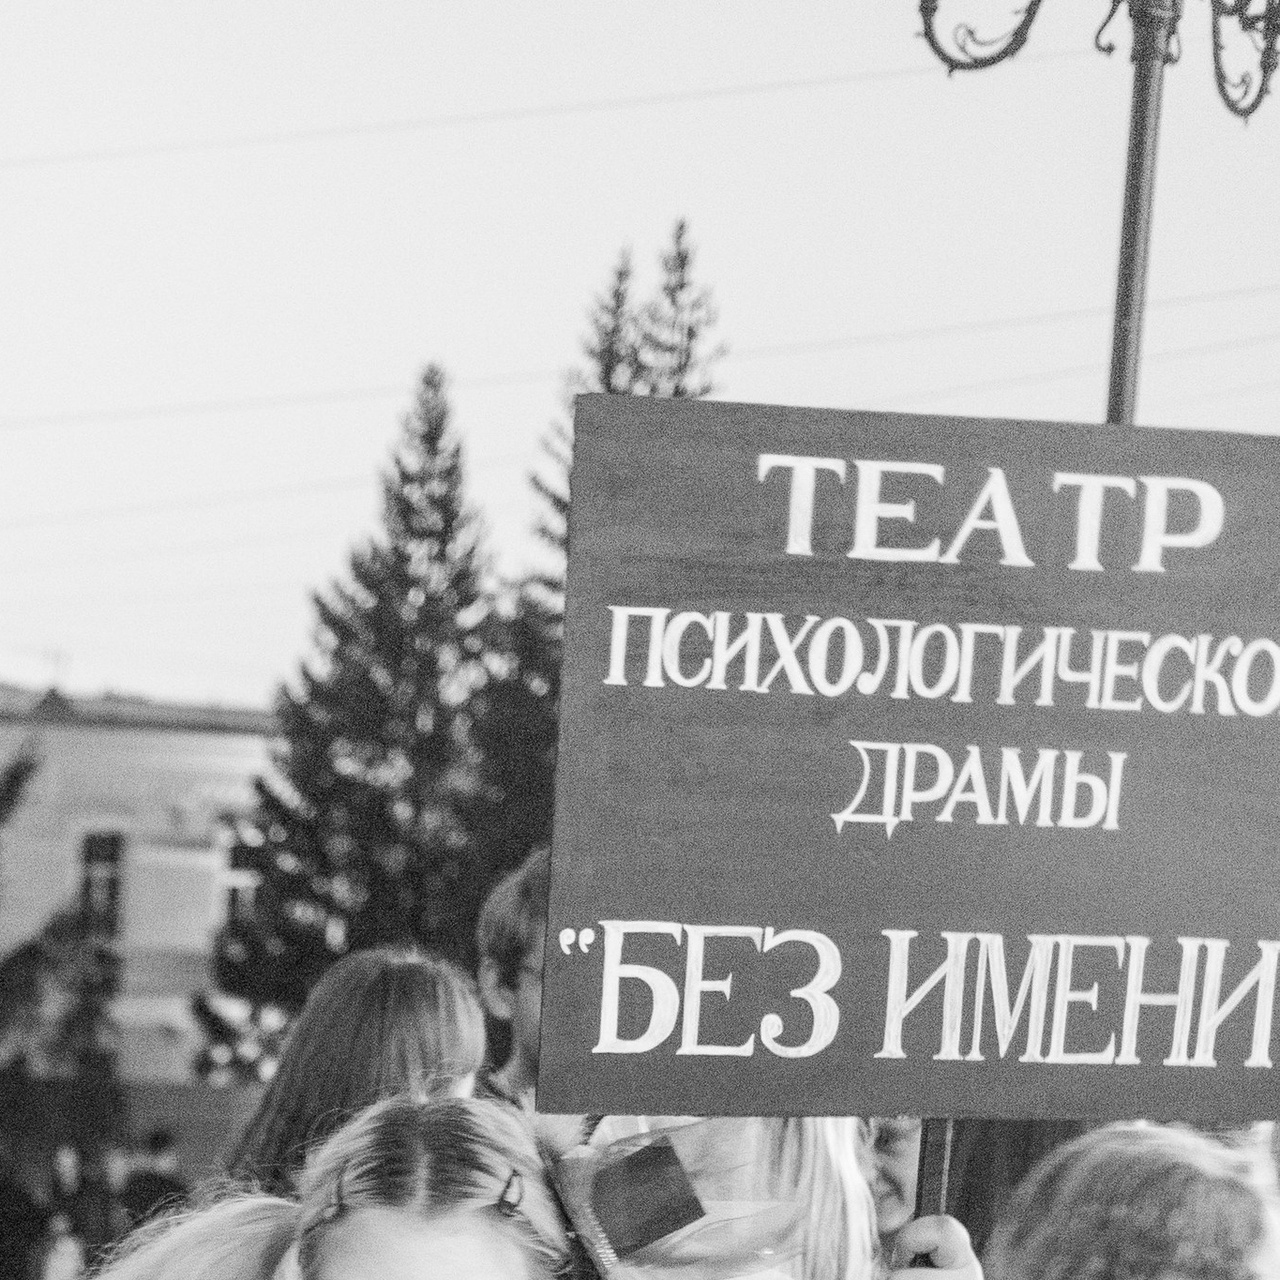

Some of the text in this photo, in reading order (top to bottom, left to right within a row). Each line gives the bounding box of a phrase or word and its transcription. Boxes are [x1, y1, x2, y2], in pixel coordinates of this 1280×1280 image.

[758, 453, 1225, 573] ТЕАТР
[603, 606, 1280, 717] ПСИХОЛОГИЧЕСКО
[832, 740, 1128, 840] ДРАМЫ
[874, 929, 1280, 1069] ИМЕНИ
